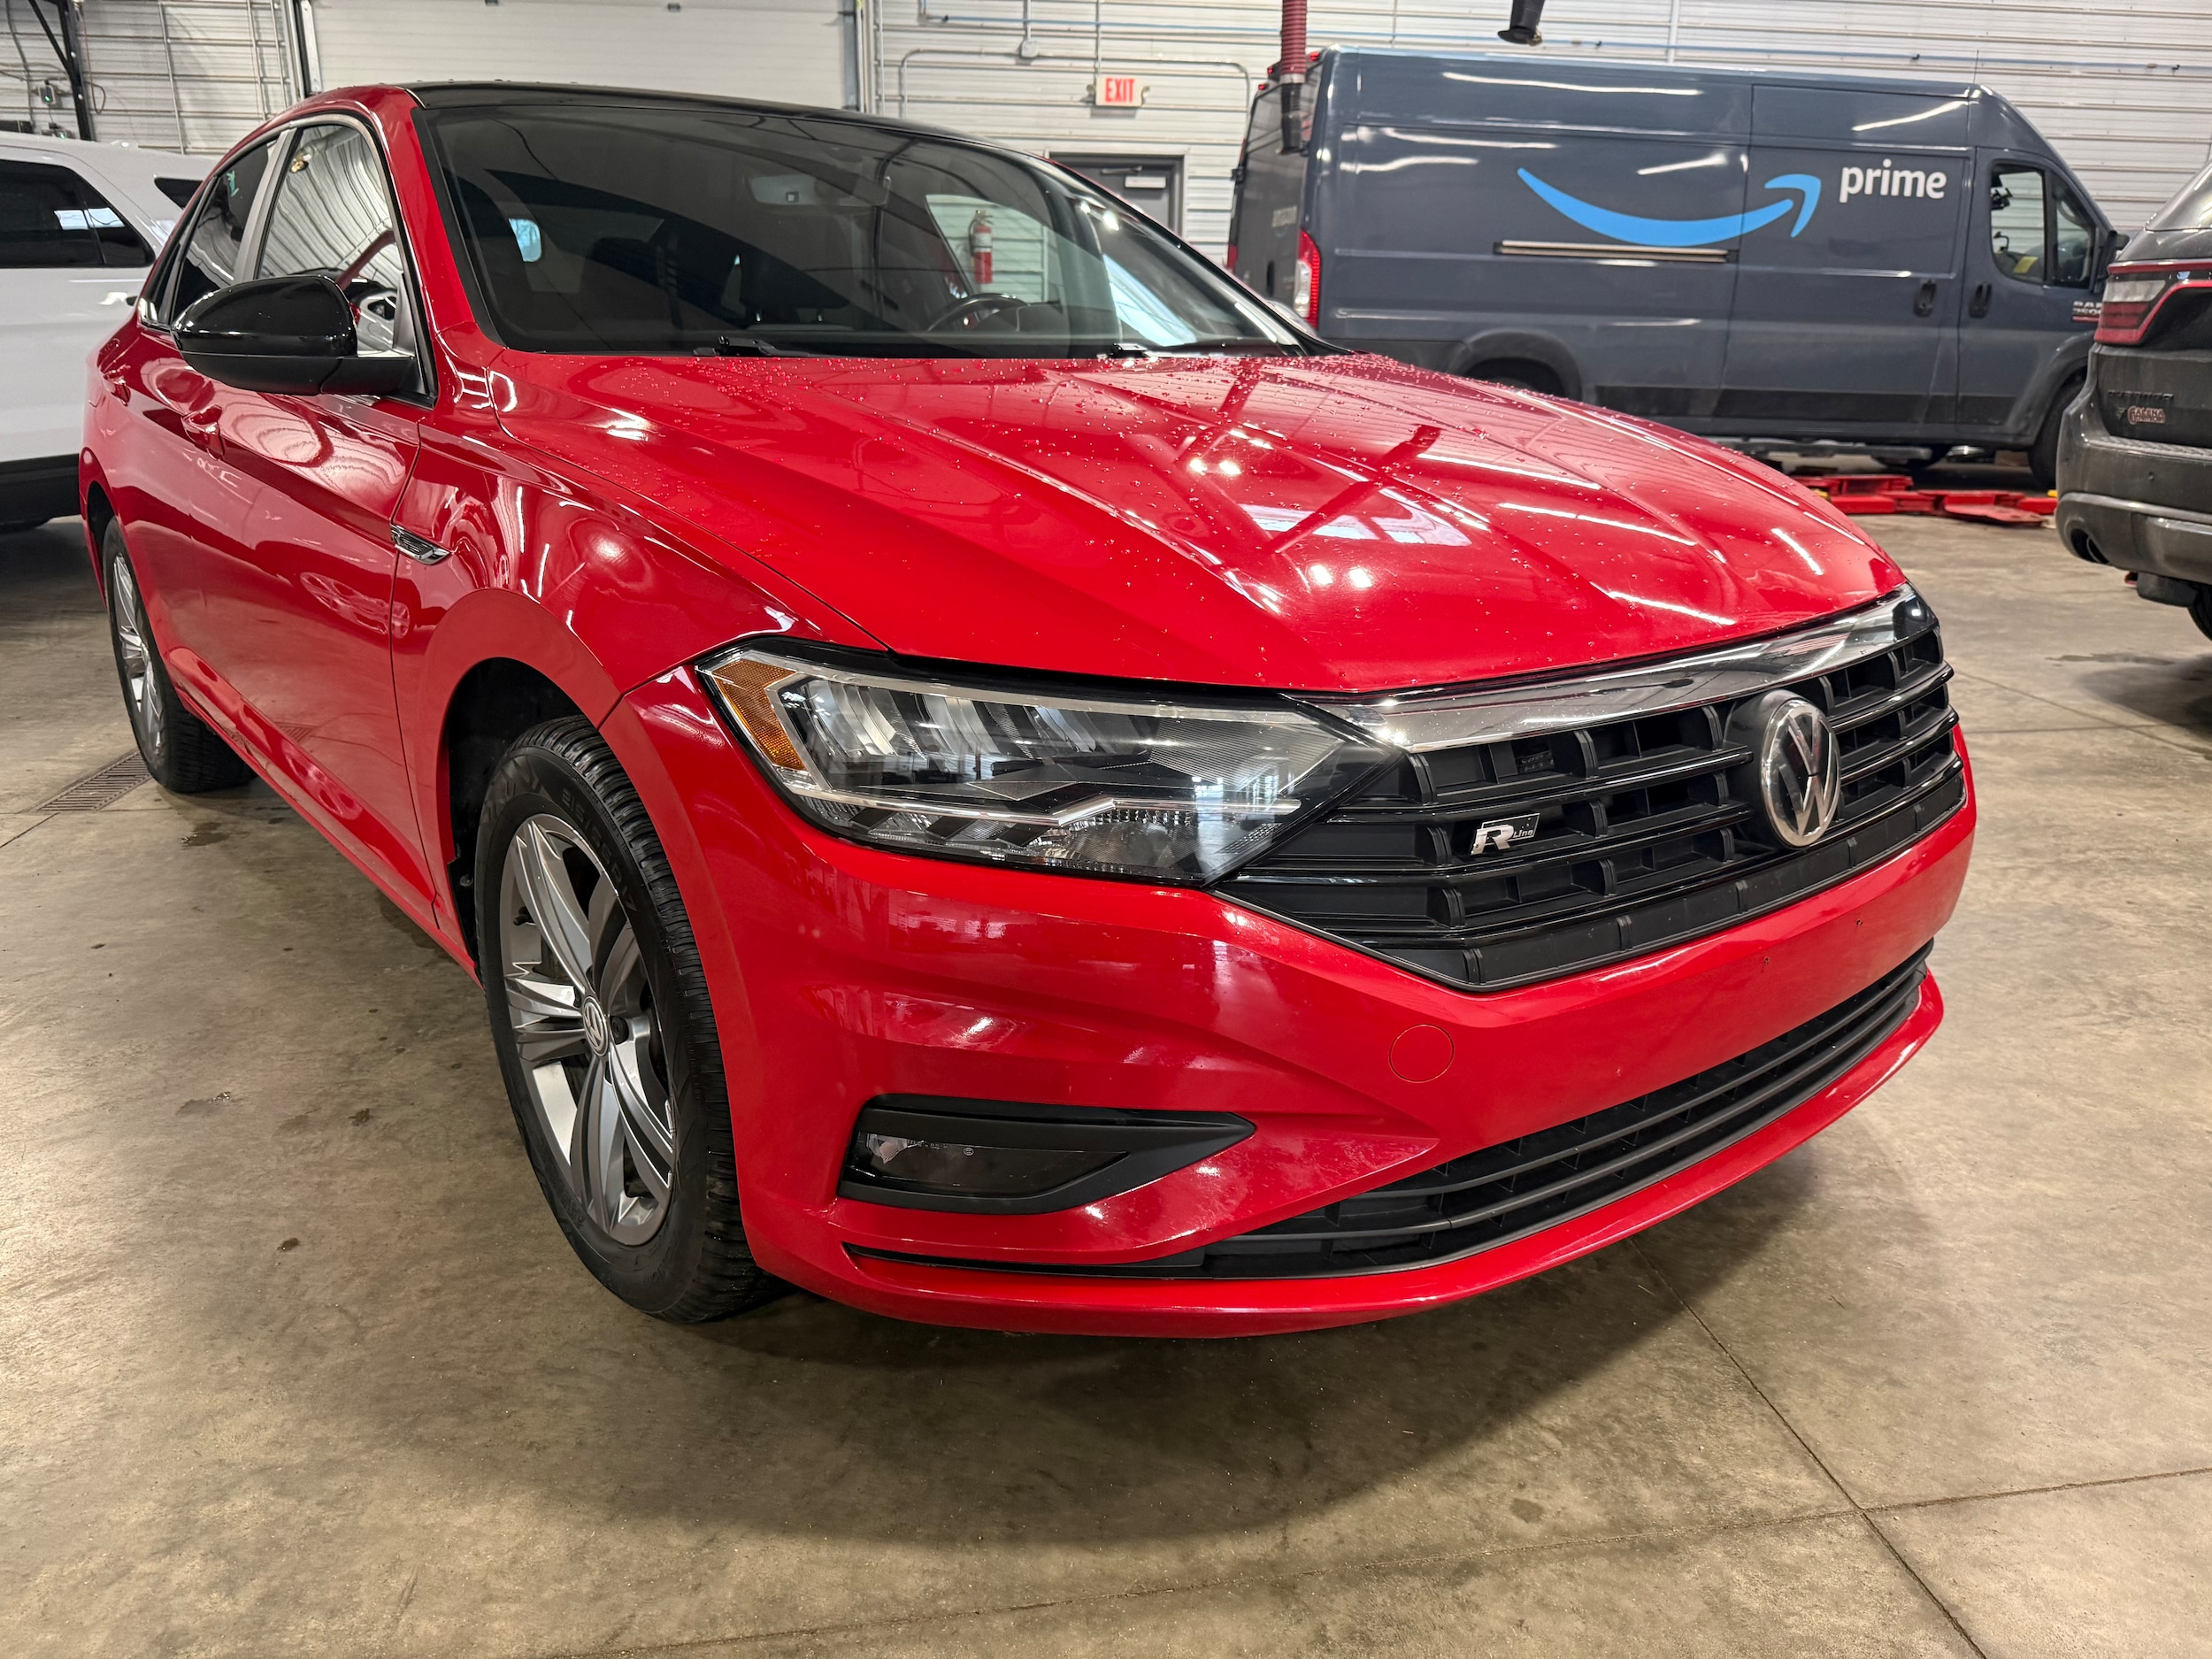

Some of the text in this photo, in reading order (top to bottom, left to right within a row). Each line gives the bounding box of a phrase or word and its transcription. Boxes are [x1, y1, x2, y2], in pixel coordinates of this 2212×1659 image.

[1105, 77, 1135, 103] EXIT
[1839, 158, 1947, 204] prime
[1471, 824, 1514, 856] R
